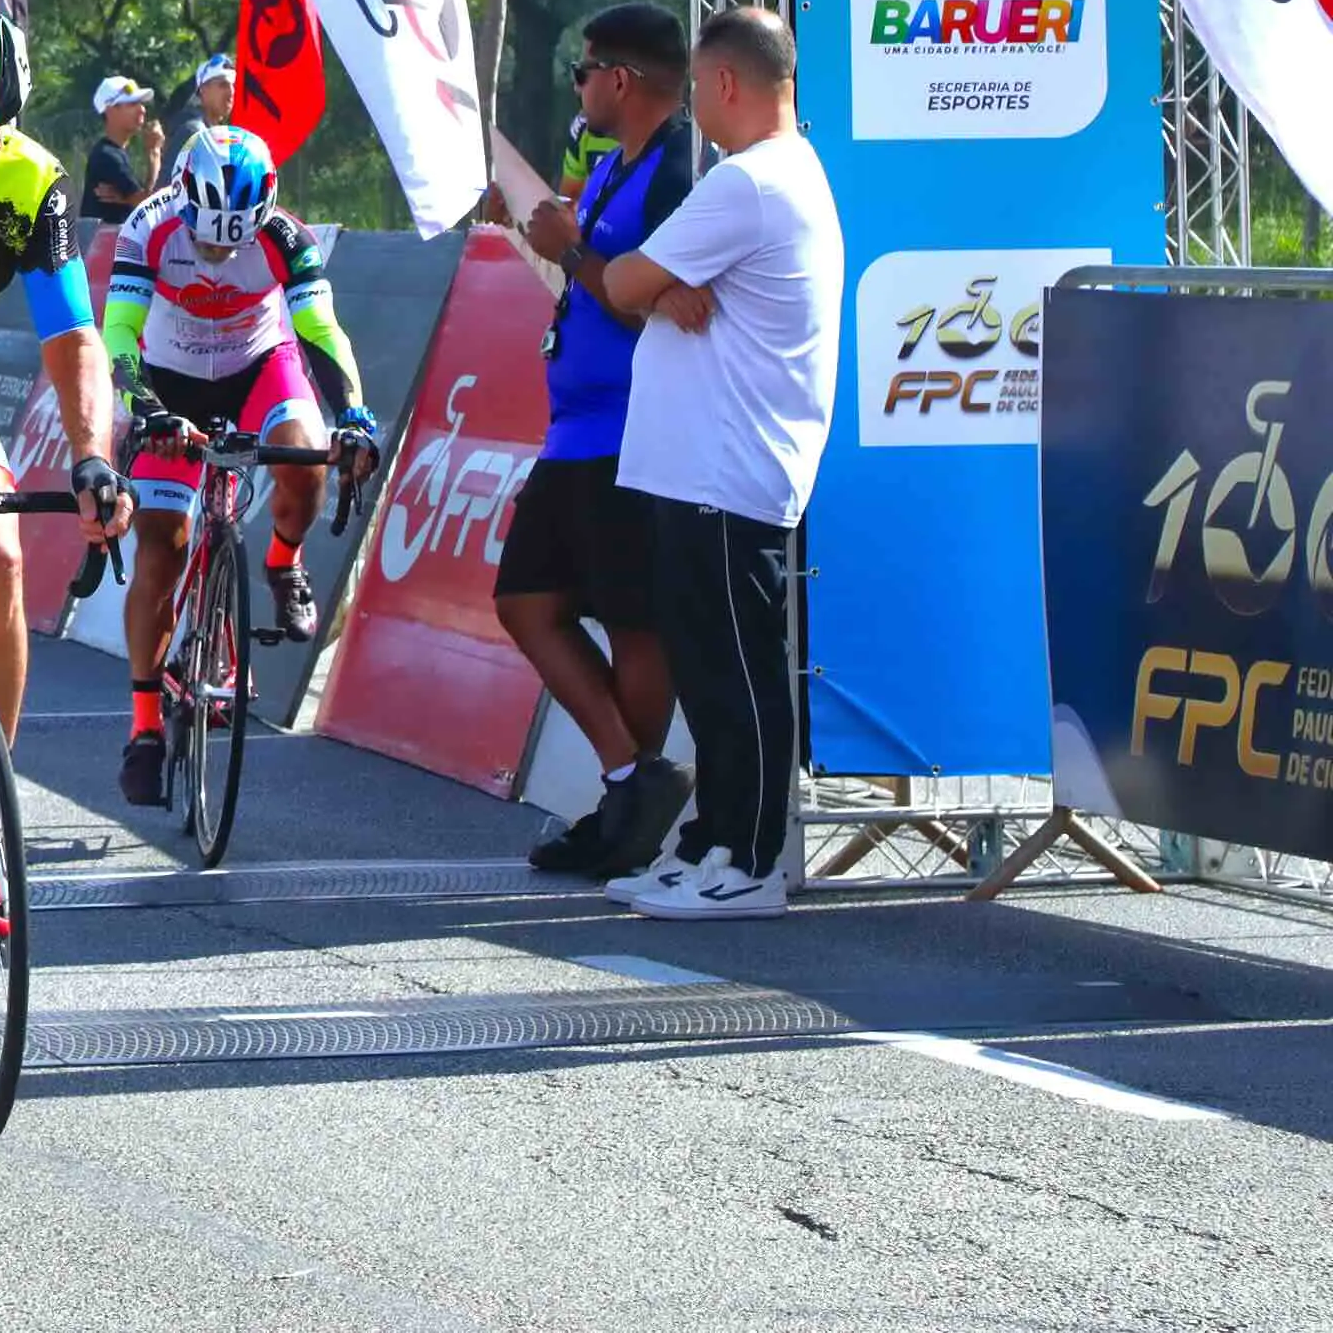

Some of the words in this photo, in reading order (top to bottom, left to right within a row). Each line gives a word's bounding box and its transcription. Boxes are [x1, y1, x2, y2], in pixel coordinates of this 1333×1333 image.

[884, 46, 910, 55] UMA
[914, 45, 959, 55] CIDADE
[964, 45, 997, 55] FEITA
[1001, 45, 1024, 55] PRA
[928, 82, 1010, 94] SECRETARIA
[1013, 81, 1032, 93] DE
[927, 95, 1031, 111] ESPORTES
[211, 213, 244, 243] 16
[884, 370, 1000, 414] FPC
[996, 400, 1014, 413] DE
[1130, 645, 1293, 779] FPC
[1285, 752, 1312, 786] DE
